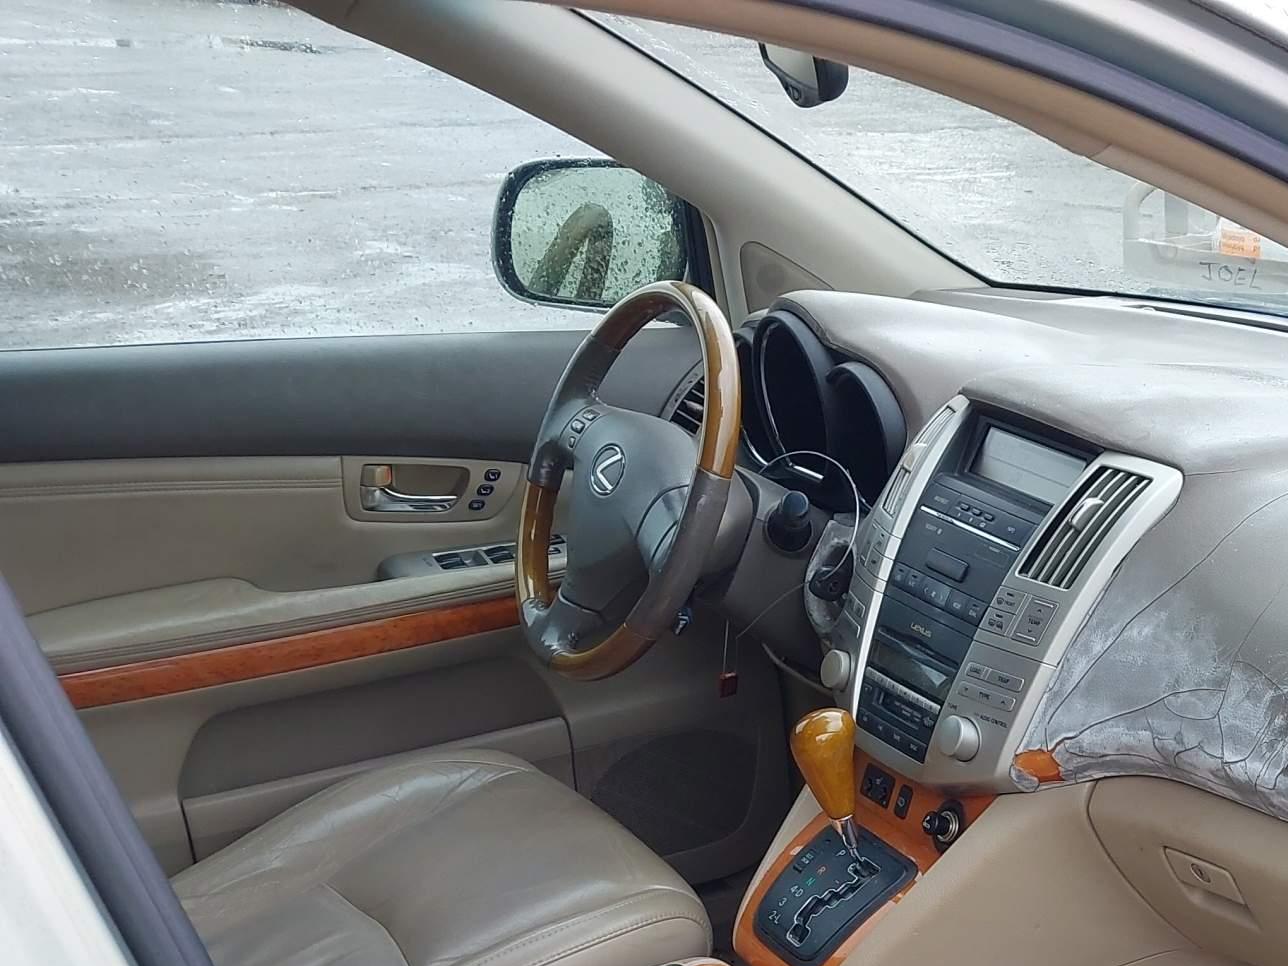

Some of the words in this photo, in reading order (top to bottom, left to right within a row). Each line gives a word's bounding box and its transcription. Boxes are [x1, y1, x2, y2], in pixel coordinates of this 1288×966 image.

[836, 849, 847, 857] P
[817, 866, 826, 876] R
[779, 897, 788, 907] 3
